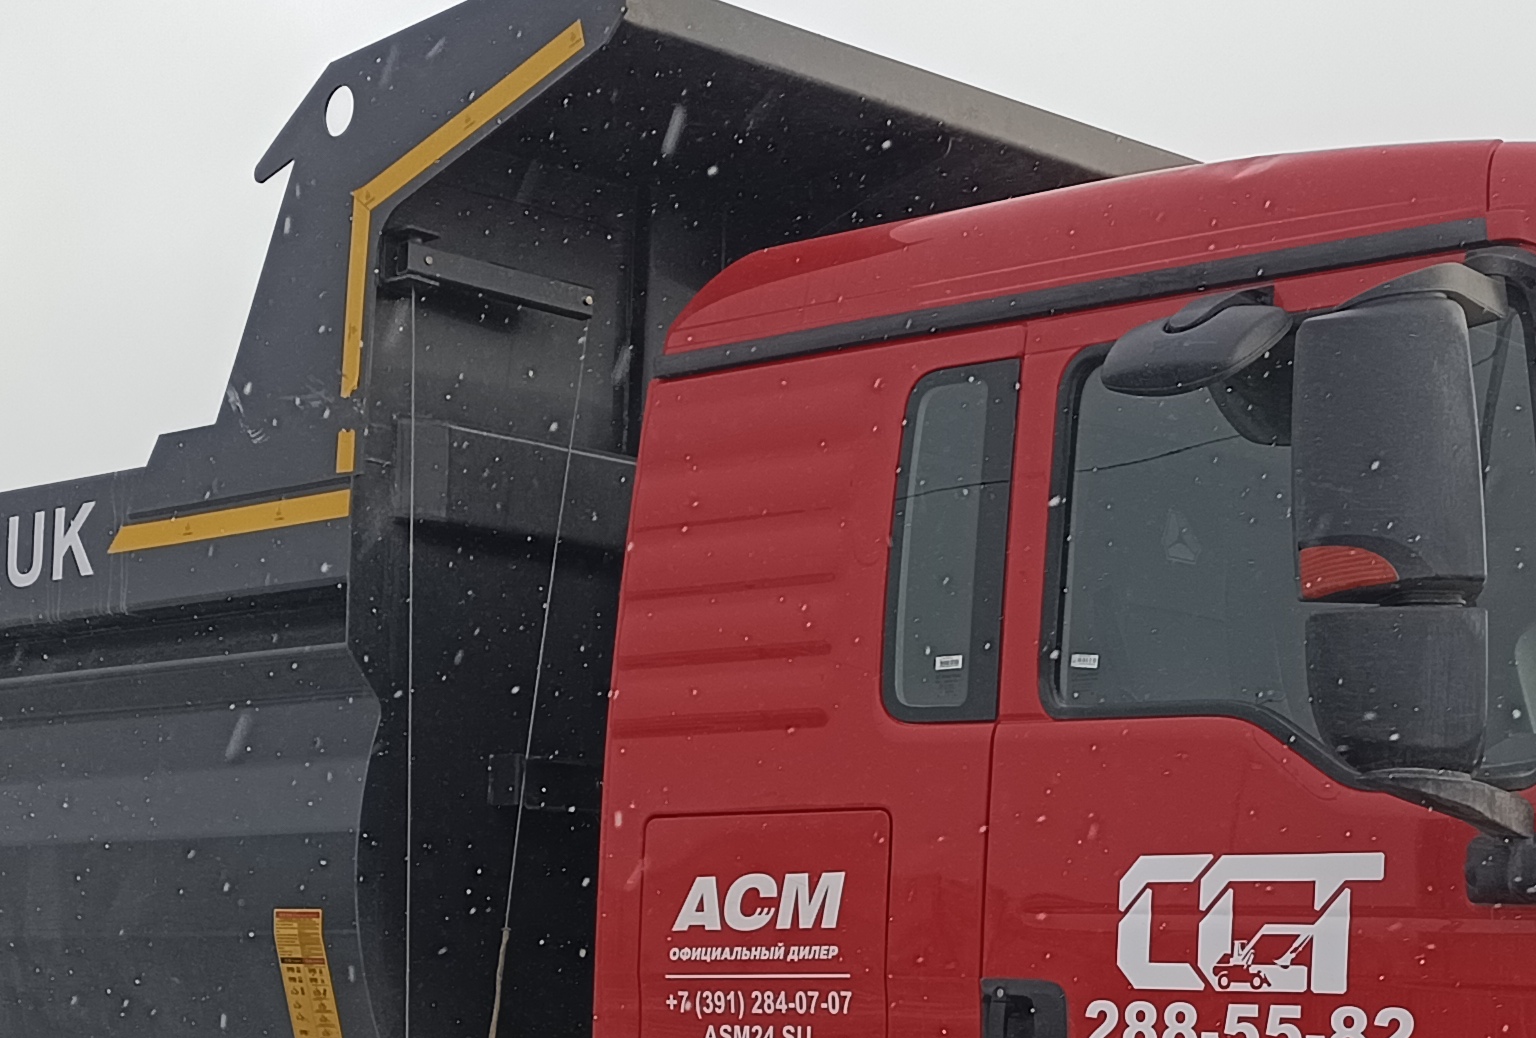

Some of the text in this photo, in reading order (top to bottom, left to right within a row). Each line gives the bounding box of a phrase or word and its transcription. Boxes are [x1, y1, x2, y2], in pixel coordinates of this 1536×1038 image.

[669, 942, 839, 962] ОФИЦИАЛЬНЫЙ ДИЛЕР
[666, 990, 852, 1019] +7 (391) 284-07-07
